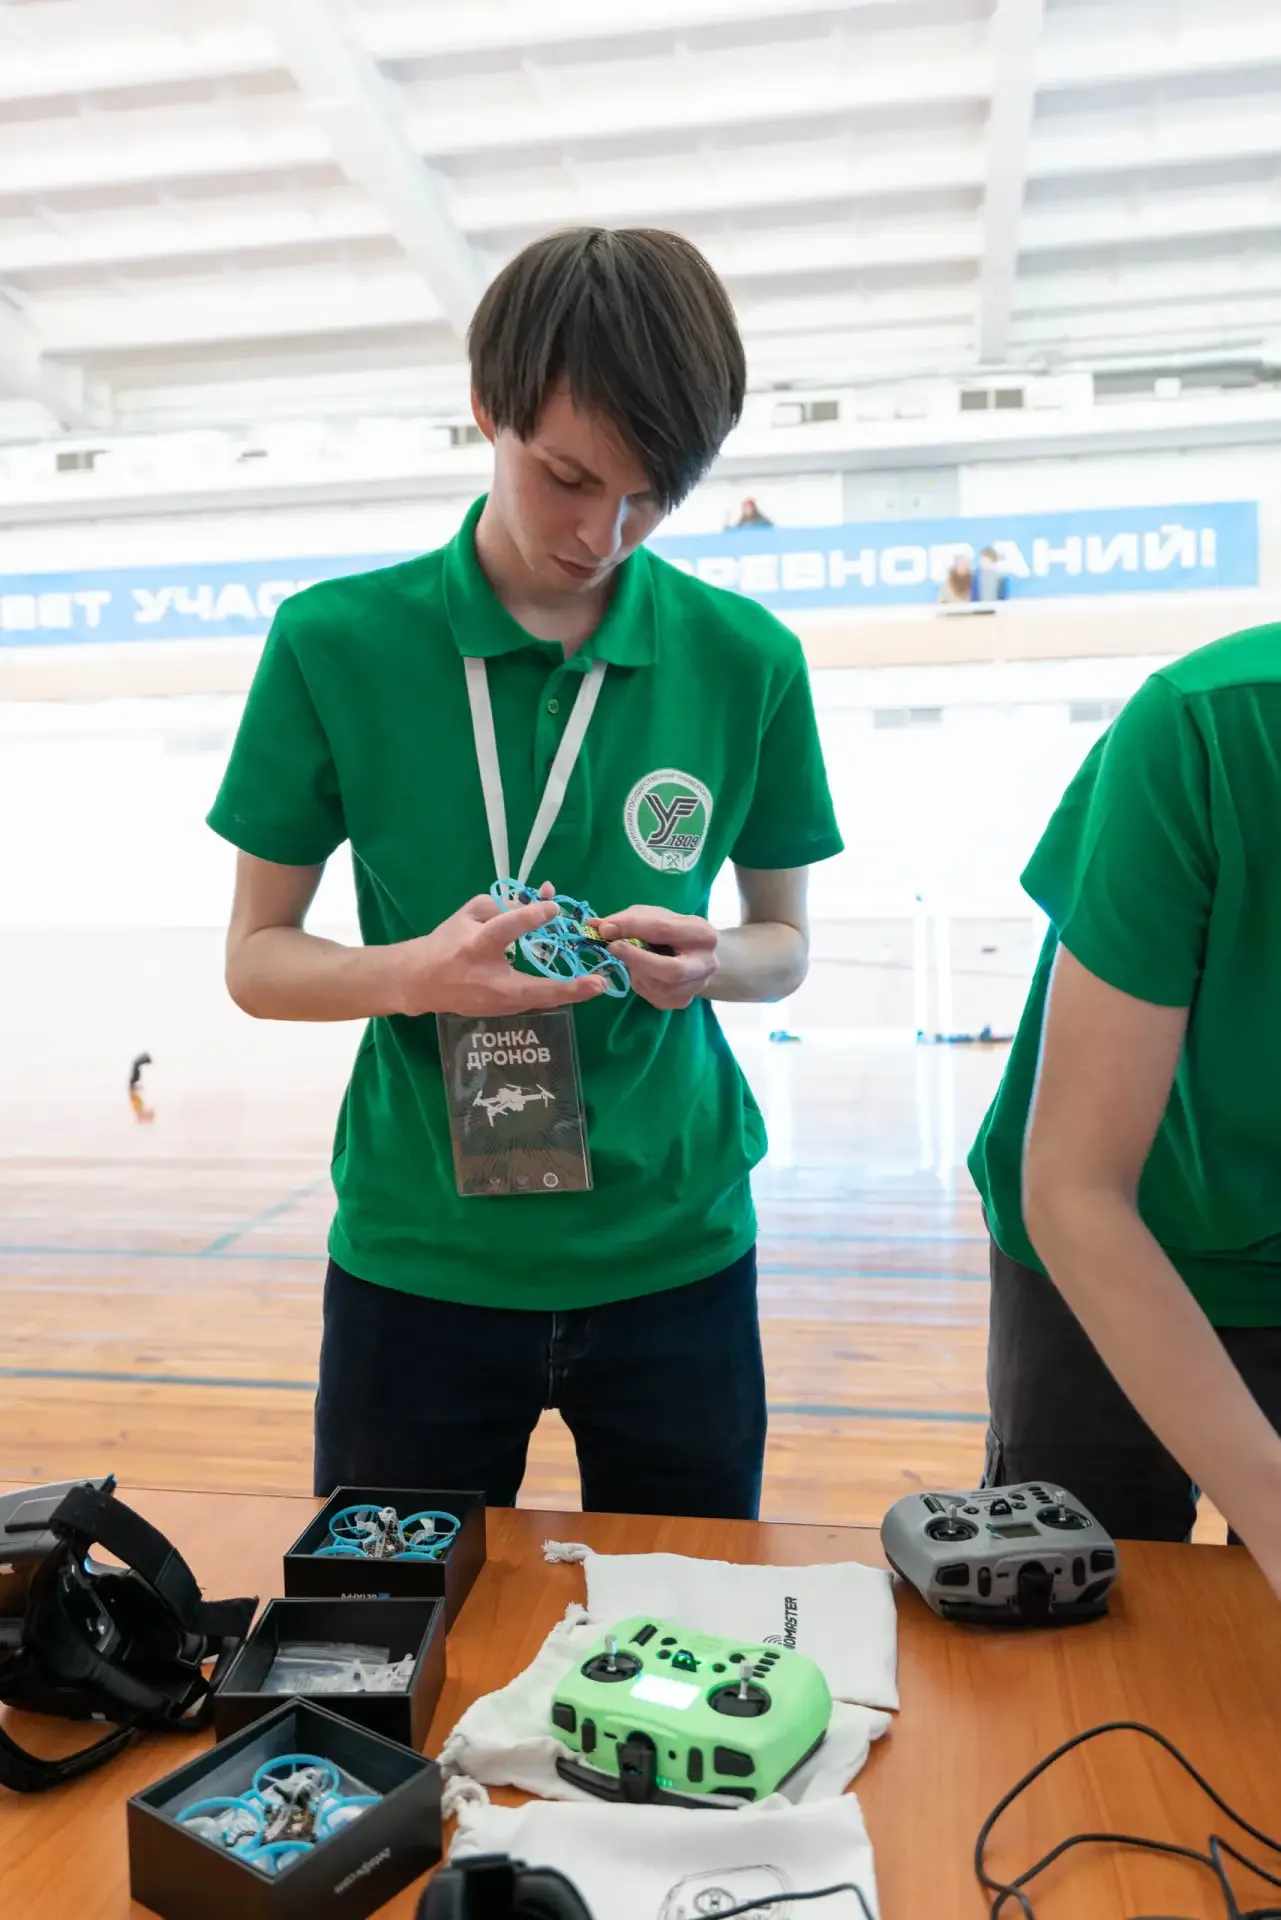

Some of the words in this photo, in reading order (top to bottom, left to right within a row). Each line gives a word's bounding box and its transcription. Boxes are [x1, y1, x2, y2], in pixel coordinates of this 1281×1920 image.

[669, 834, 699, 848] 1809
[471, 1029, 540, 1049] ГОНКА
[466, 1047, 552, 1070] ДРОНОВ
[782, 1596, 798, 1650] IOMASTER
